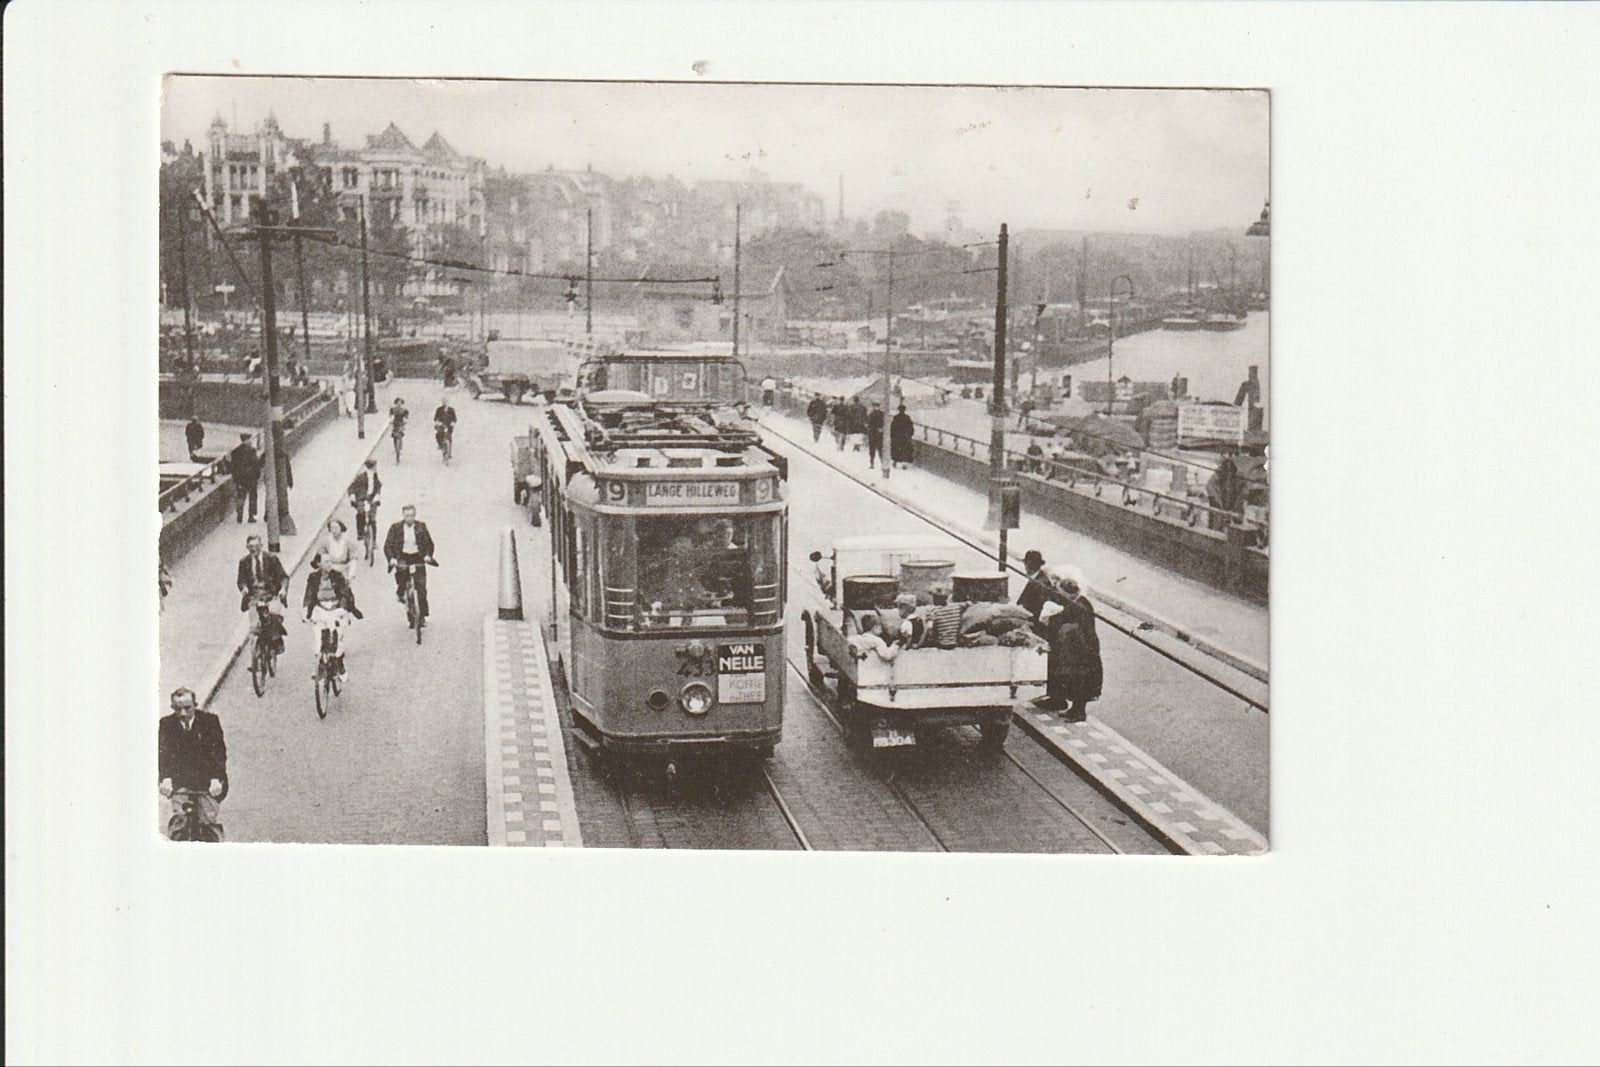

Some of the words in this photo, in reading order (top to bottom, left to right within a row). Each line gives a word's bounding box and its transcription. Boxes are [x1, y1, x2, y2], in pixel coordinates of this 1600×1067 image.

[608, 481, 625, 501] 9
[650, 483, 682, 498] LANGE
[686, 484, 737, 498] HILLEWEG
[757, 480, 770, 500] 9
[729, 645, 754, 655] VAN
[719, 655, 764, 671] NELLE
